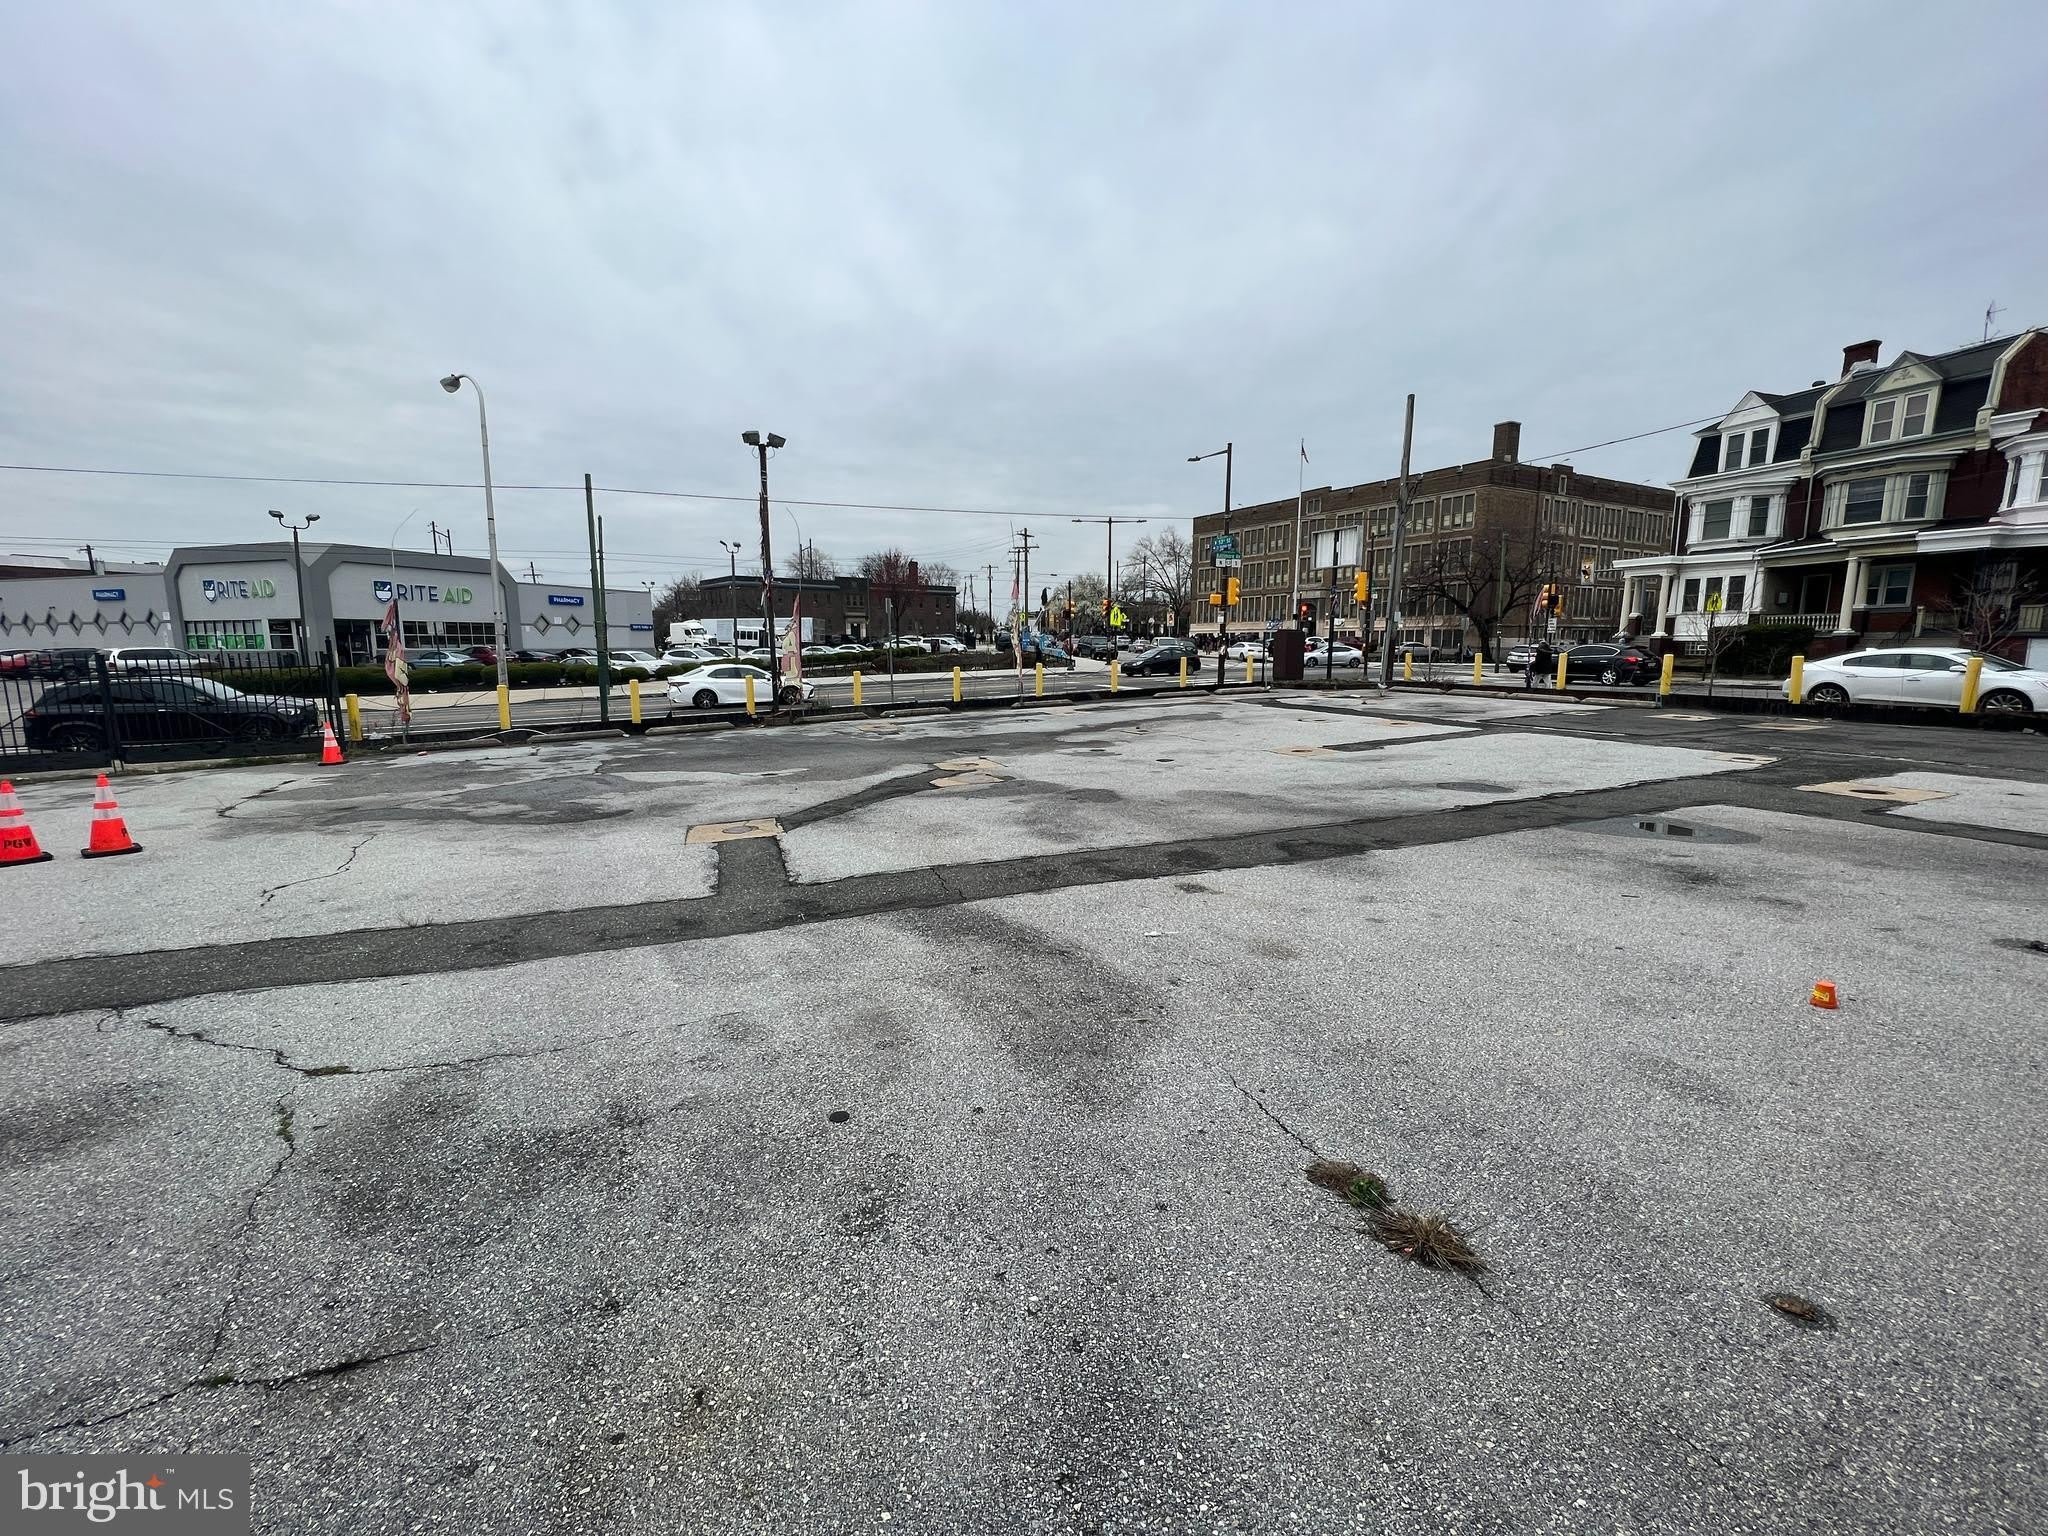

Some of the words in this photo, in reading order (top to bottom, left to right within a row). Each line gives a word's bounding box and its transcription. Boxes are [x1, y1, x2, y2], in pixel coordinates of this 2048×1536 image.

[217, 580, 250, 599] RITE
[251, 579, 276, 599] AID
[396, 583, 440, 602] RITE
[442, 586, 474, 604] AID
